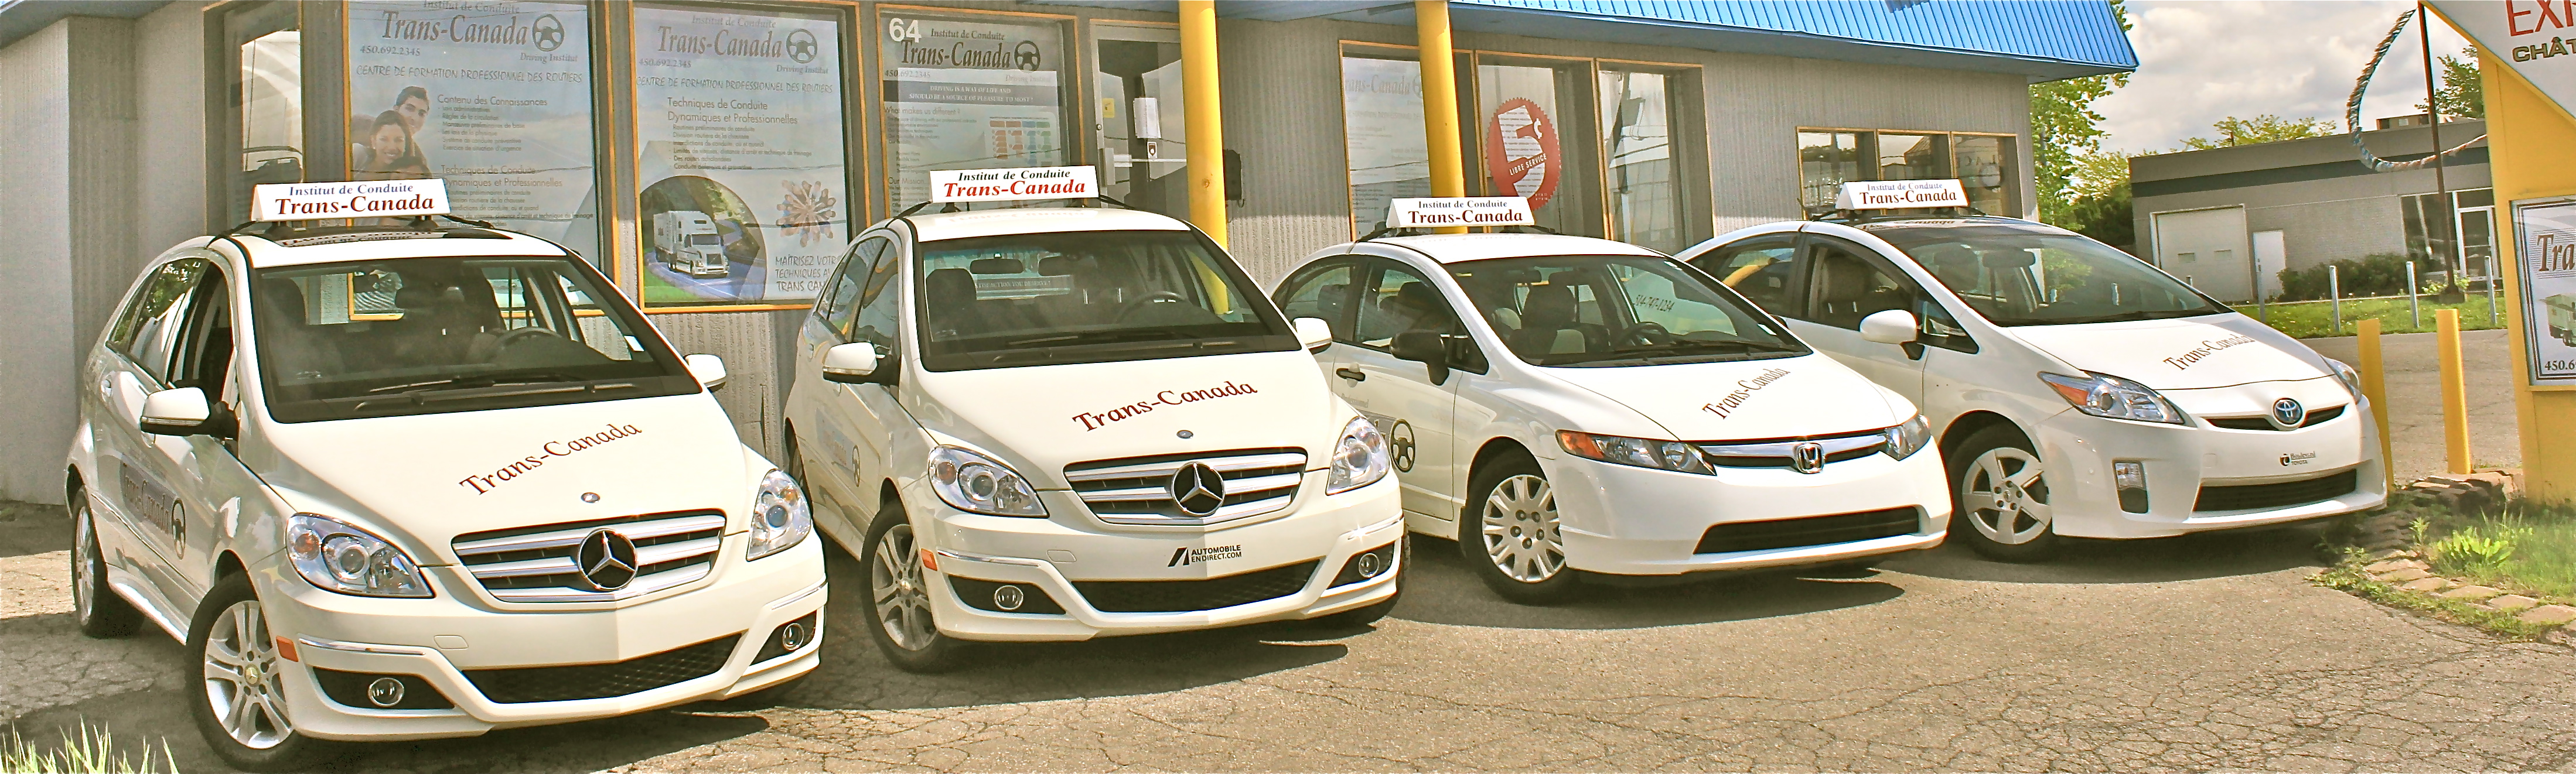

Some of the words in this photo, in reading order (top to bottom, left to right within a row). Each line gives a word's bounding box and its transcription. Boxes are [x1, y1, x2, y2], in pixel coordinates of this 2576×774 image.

[476, 2, 520, 13] Conduite
[382, 10, 529, 45] Trans-Canada
[691, 15, 723, 26] Institut
[725, 16, 735, 26] de
[738, 18, 777, 28] Conduite
[889, 18, 922, 43] 64
[930, 28, 959, 38] Institut
[961, 29, 970, 39] de
[971, 30, 1005, 40] Conduite
[657, 26, 782, 58] Trans-Canada
[360, 46, 421, 56] 450.692.2345
[900, 39, 1011, 69] Trans-Canada
[520, 52, 547, 64] Driving
[639, 58, 691, 68] 450.692.2345
[356, 65, 391, 76] CENTRE
[394, 66, 405, 76] DE
[409, 67, 458, 78] FORMATION
[461, 69, 524, 82] PROFESSIONNEL
[527, 71, 543, 82] DES
[546, 71, 583, 83] ROUTIERS
[776, 64, 803, 75] Driving
[885, 70, 931, 78] 450.692.2345
[636, 76, 666, 86] CENTRE
[668, 77, 678, 87] DE
[681, 78, 723, 89] FORMATION
[725, 80, 783, 91] PROFESSIONNEL
[786, 82, 800, 93] DES
[802, 83, 833, 94] ROUTIERS
[437, 94, 472, 105] Contenu
[474, 94, 488, 105] des
[490, 96, 548, 106] Connaissances
[667, 97, 715, 110] Techniques
[718, 98, 728, 109] de
[731, 100, 768, 110] Conduite
[902, 107, 923, 115] makes
[667, 111, 721, 124] Dynamiques
[724, 114, 731, 122] et
[733, 113, 798, 124] Professionnelles
[1509, 162, 1525, 176] LIBRE
[1525, 152, 1547, 169] SERVICE
[441, 165, 485, 176] Techniques
[488, 165, 499, 174] de
[500, 165, 535, 174] Conduite
[958, 172, 999, 181] Institut
[1003, 171, 1016, 180] de
[1021, 169, 1071, 179] Conduite
[494, 179, 502, 187] et
[504, 177, 563, 187] Professionnelles
[944, 179, 1086, 197] Trans-Canada
[1867, 183, 1895, 191] Institut
[289, 186, 336, 196] Institut
[339, 185, 353, 195] de
[357, 183, 414, 194] Conduite
[1859, 189, 1957, 205] Trans-Canada
[275, 194, 435, 215] Trans-Canada
[1454, 200, 1465, 208] de
[1467, 200, 1507, 208] Conduite
[1408, 209, 1523, 224] Trans-Canada
[774, 254, 814, 266] MAÎTRISEZ
[817, 255, 837, 266] VOTR
[774, 268, 821, 279] TECHNIQUES
[776, 281, 804, 292] TRANS
[2162, 334, 2255, 371] Trans-Canada
[2544, 359, 2576, 371] 450.6
[1702, 368, 1791, 420] Trans-Canada
[1072, 381, 1258, 432] Trans-Canada
[459, 423, 643, 496] Trans-Canada
[1191, 544, 1241, 556] AUTOMOBILE
[1191, 551, 1242, 563] ENDIRECT.COM
